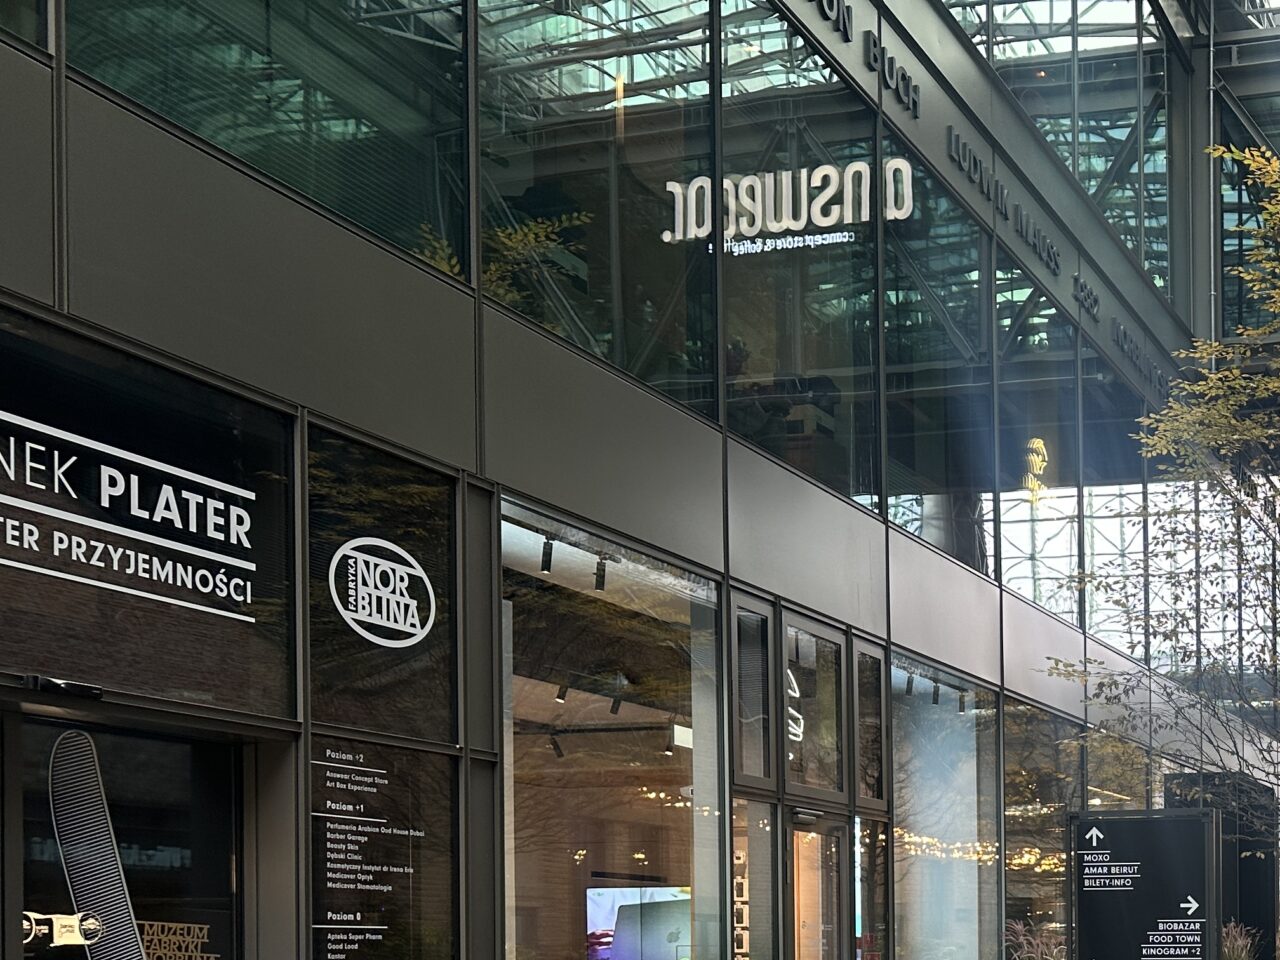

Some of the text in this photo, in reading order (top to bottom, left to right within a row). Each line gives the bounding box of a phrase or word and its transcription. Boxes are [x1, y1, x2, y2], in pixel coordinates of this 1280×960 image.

[862, 29, 920, 119] BUCH
[947, 125, 1009, 220] LUDWIK
[1014, 203, 1061, 276] MAUSS
[100, 464, 252, 549] PLATER
[53, 530, 252, 604] PRZYJEMNOŚCI
[348, 558, 356, 611] FABRYKA
[326, 749, 364, 762] Poziom +2
[326, 770, 388, 785] Answear Concept Store
[348, 783, 377, 792] Experience
[326, 800, 364, 812] Poziom +1
[326, 822, 356, 831] Perfumeria
[358, 825, 379, 833] Arabian
[410, 829, 424, 837] Dubai
[347, 834, 368, 843] Garage
[326, 842, 345, 850] Beauty
[1084, 854, 1110, 862] MOXO
[1084, 866, 1138, 874] AMAR BEIRUT
[326, 871, 373, 882] Medicover Optyk
[326, 881, 392, 892] Medicover Stomatologia
[1084, 878, 1132, 887] BILETY-INFO
[327, 911, 354, 920] Poziom
[144, 923, 208, 940] MUZEUM
[1158, 922, 1201, 930] BIOBAZAR
[327, 933, 347, 941] Apteka
[348, 933, 364, 941] Super
[1149, 935, 1200, 943] FOOD TOWN
[143, 937, 201, 954] FABRYKI
[1142, 947, 1201, 955] KINOGRAM +2
